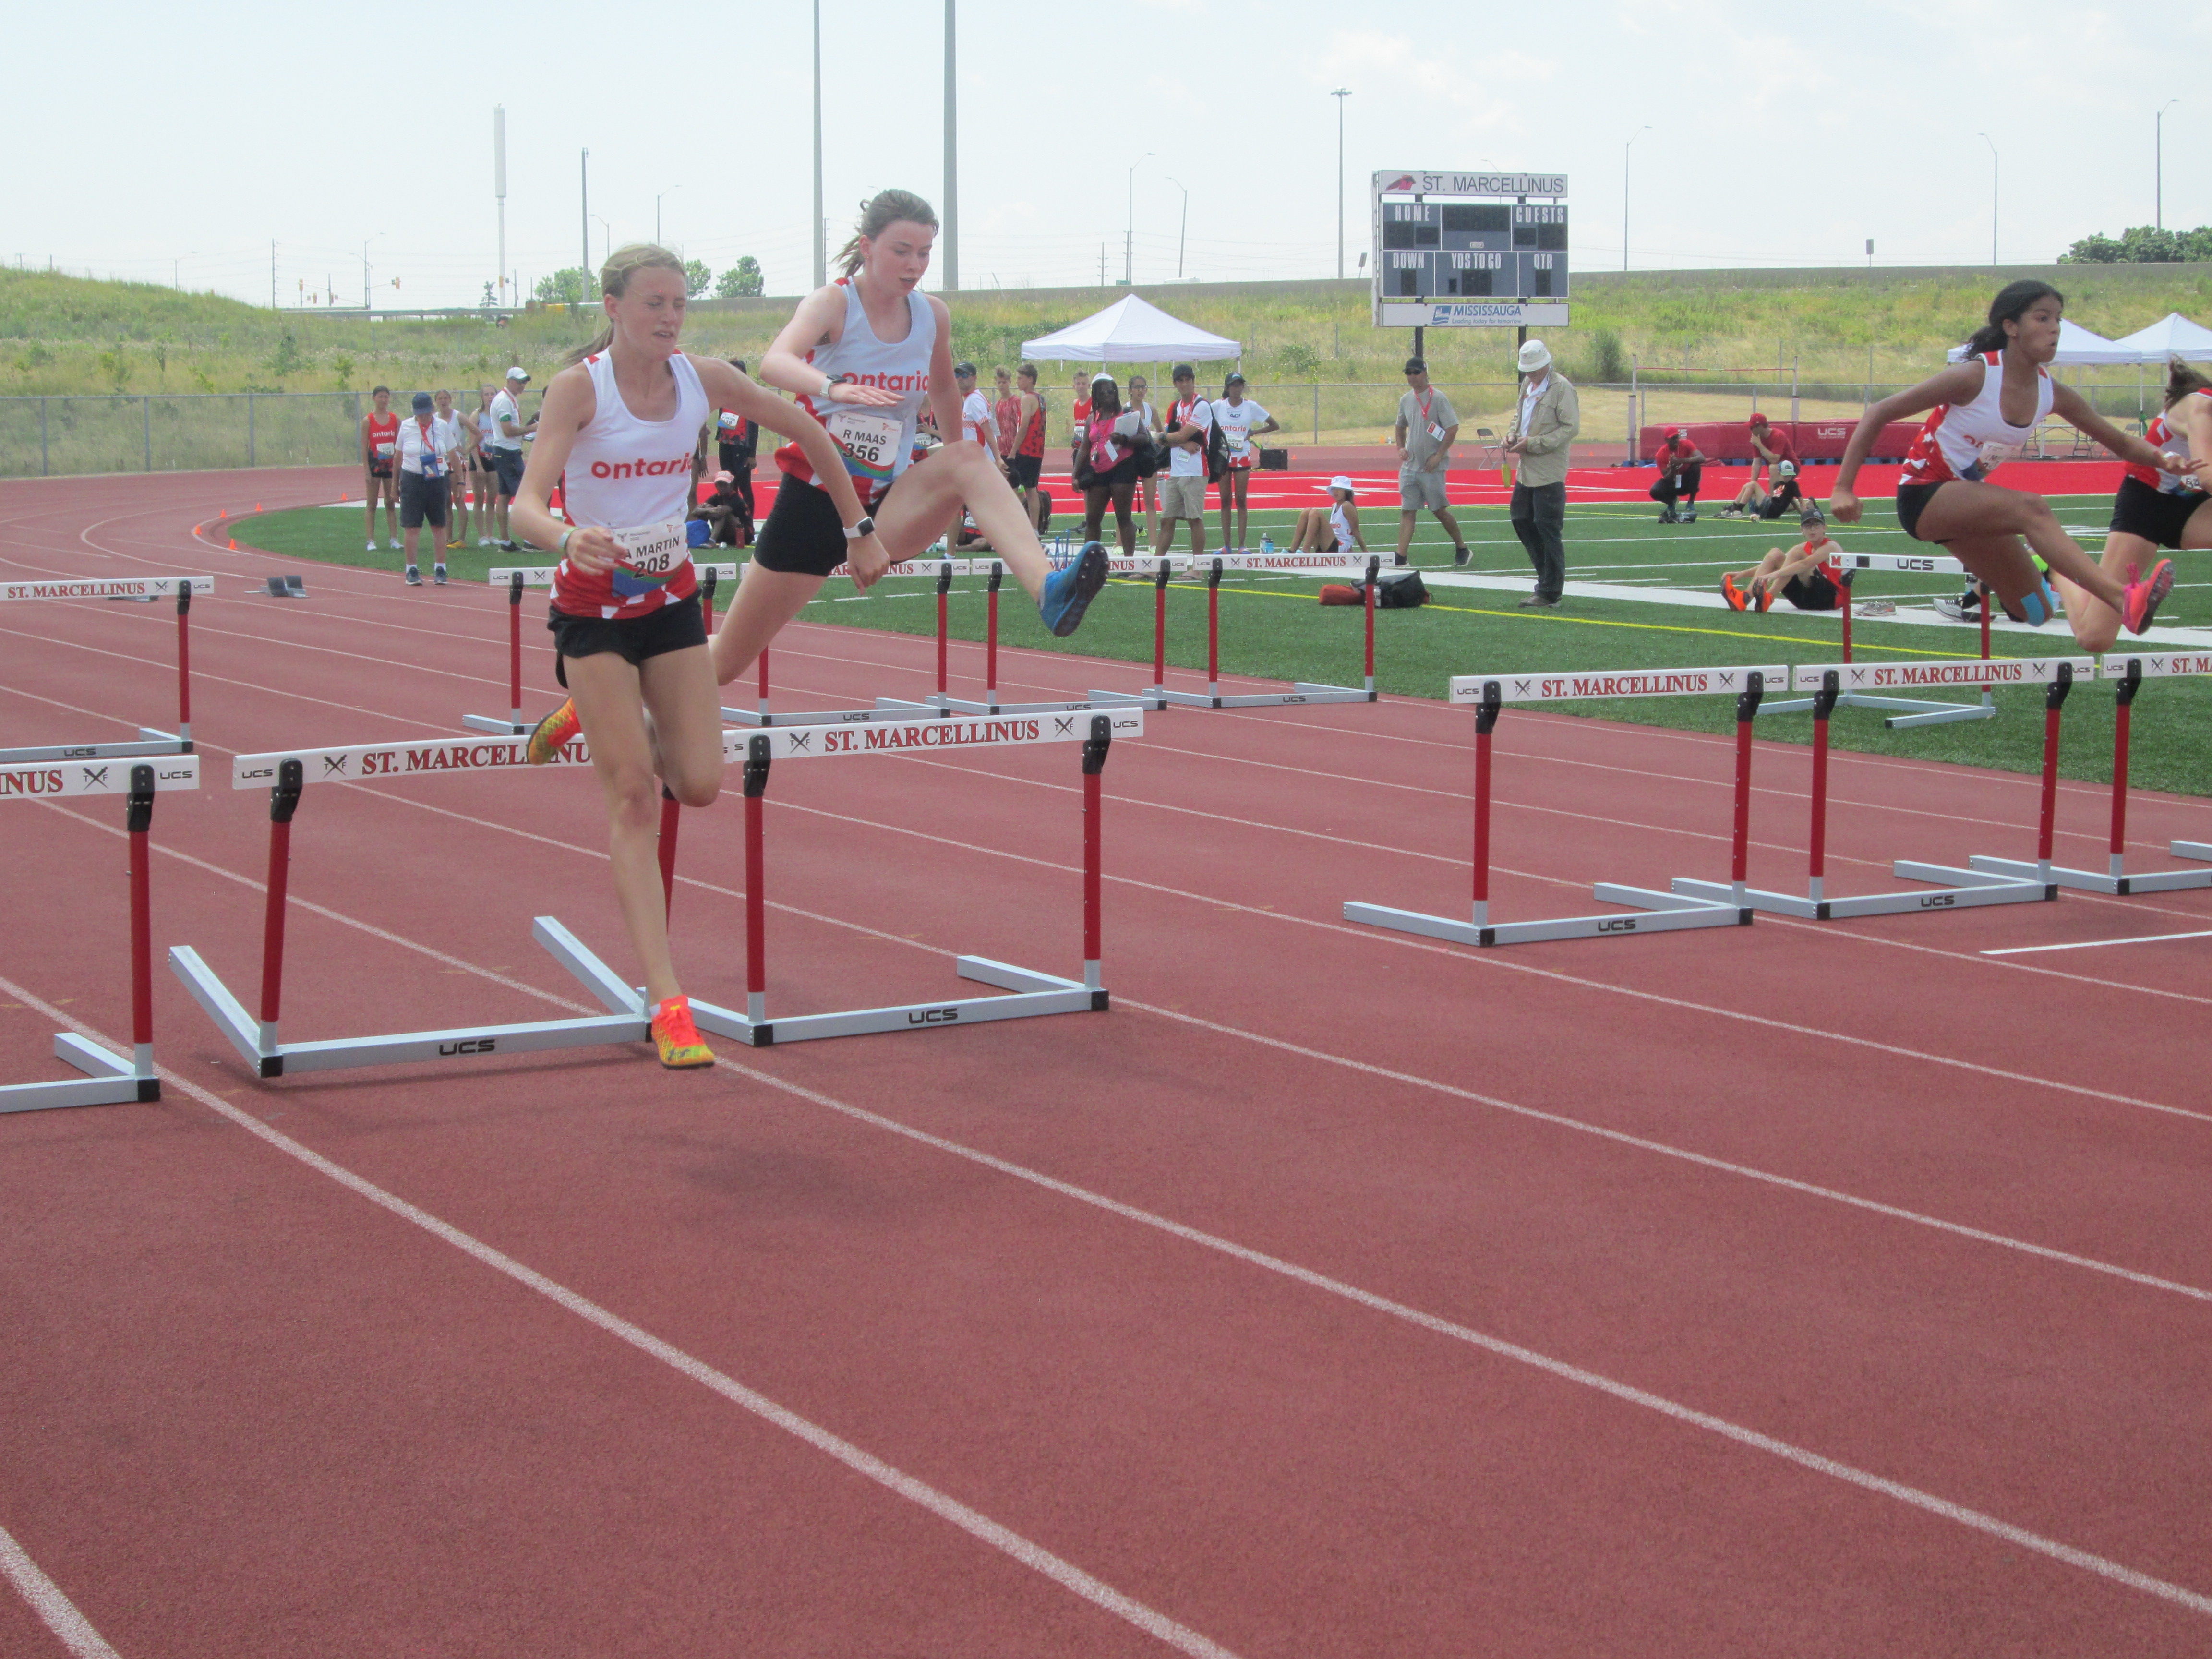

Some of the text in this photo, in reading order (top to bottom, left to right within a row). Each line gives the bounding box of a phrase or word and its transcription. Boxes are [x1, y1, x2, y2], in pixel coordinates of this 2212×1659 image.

[1422, 176, 1563, 192] ST. MARCELLINUS
[1395, 205, 1430, 221] HOME
[1516, 207, 1563, 223] GUESTS
[1393, 253, 1425, 268] DOWN
[1451, 252, 1502, 269] YDS TO GO
[1533, 254, 1553, 269] QTR
[1454, 305, 1522, 316] MISSISSAUGA
[842, 429, 887, 445] R MAAS
[1817, 427, 1846, 435] UCS
[842, 442, 880, 462] 356
[591, 452, 692, 480] ontari
[636, 536, 680, 558] MARTIN
[632, 553, 670, 579] 208
[1246, 556, 1346, 568] ST. MARCELLINUS
[1897, 558, 1934, 571] UCS
[7, 582, 146, 599] ST. MARCELLINUS
[2172, 657, 2212, 673] ST. M
[1874, 664, 2022, 685] ST. MARCELLINUS
[1541, 674, 1708, 697] ST. MARCELLINUS
[825, 720, 1040, 752] ST. MARCELLINUS
[64, 748, 96, 757] UCS
[361, 742, 591, 775] ST. MARCELNU
[0, 769, 63, 794] NUS
[159, 771, 192, 779] UCS
[241, 769, 274, 779] UCS
[1921, 895, 1955, 907] UCS
[1598, 919, 1636, 932] UCS
[909, 1008, 958, 1024] UCS
[439, 1039, 495, 1056] UCS
